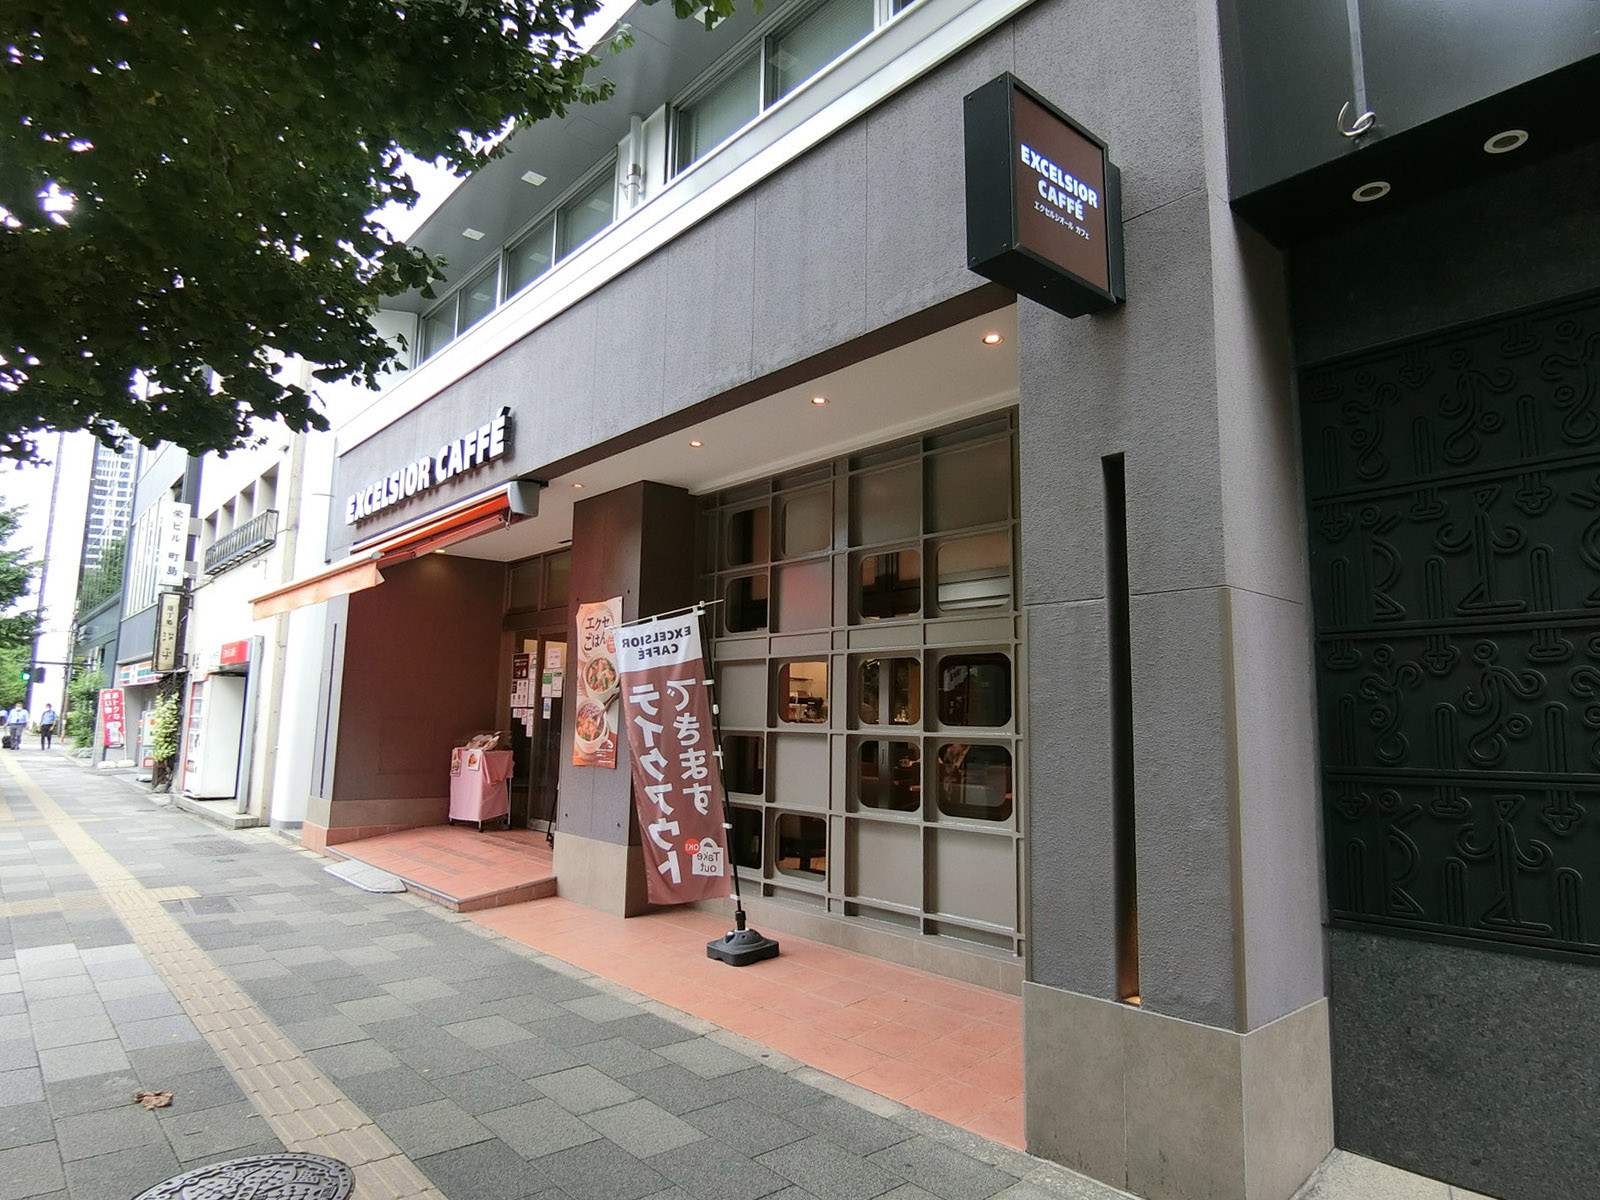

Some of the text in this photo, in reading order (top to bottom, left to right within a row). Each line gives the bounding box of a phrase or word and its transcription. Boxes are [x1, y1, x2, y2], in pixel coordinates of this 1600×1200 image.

[1020, 143, 1098, 209] EXCELSIOR
[1037, 178, 1084, 221] CAFFÉ
[1075, 225, 1090, 240] カフェ
[345, 406, 512, 525] EXCELSIOR CAFFÉ
[585, 616, 610, 631] エクセ
[584, 631, 606, 651] ごはん
